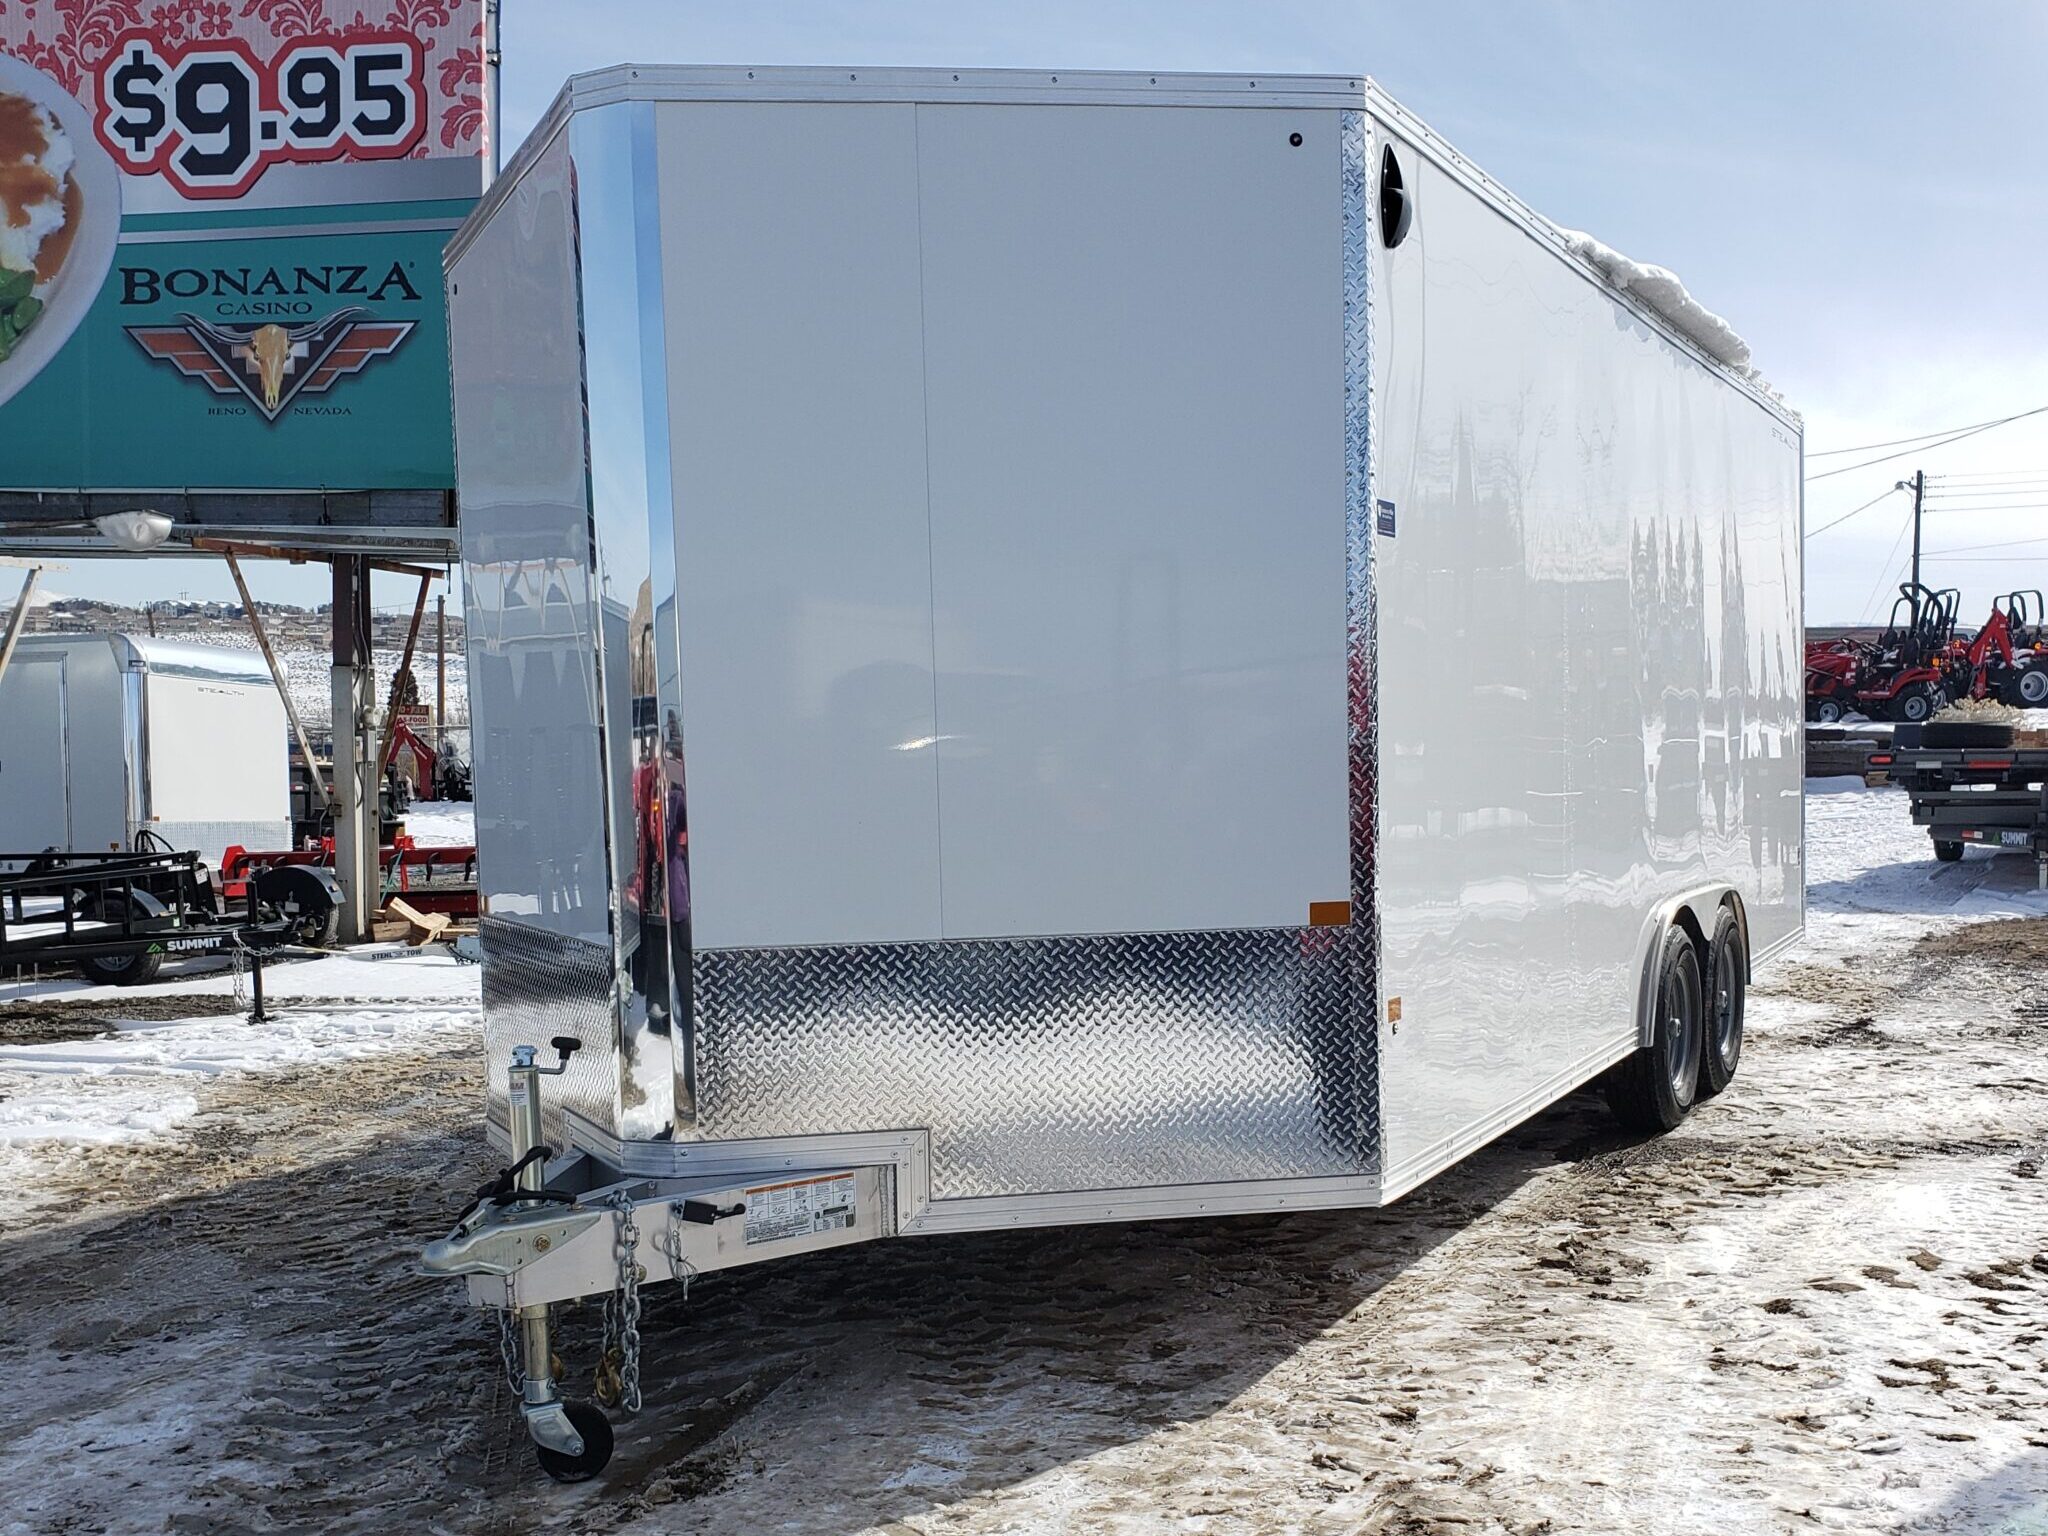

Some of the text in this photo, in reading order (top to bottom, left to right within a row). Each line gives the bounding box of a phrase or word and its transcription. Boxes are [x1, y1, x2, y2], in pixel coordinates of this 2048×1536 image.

[112, 48, 407, 176] $9.95
[119, 262, 422, 305] BONANZA
[216, 301, 313, 316] CASINO
[207, 407, 352, 416] RENO NEVADA
[2001, 831, 2028, 846] SUMMIT
[166, 937, 222, 951] SUMMIT
[406, 948, 423, 957] TOW
